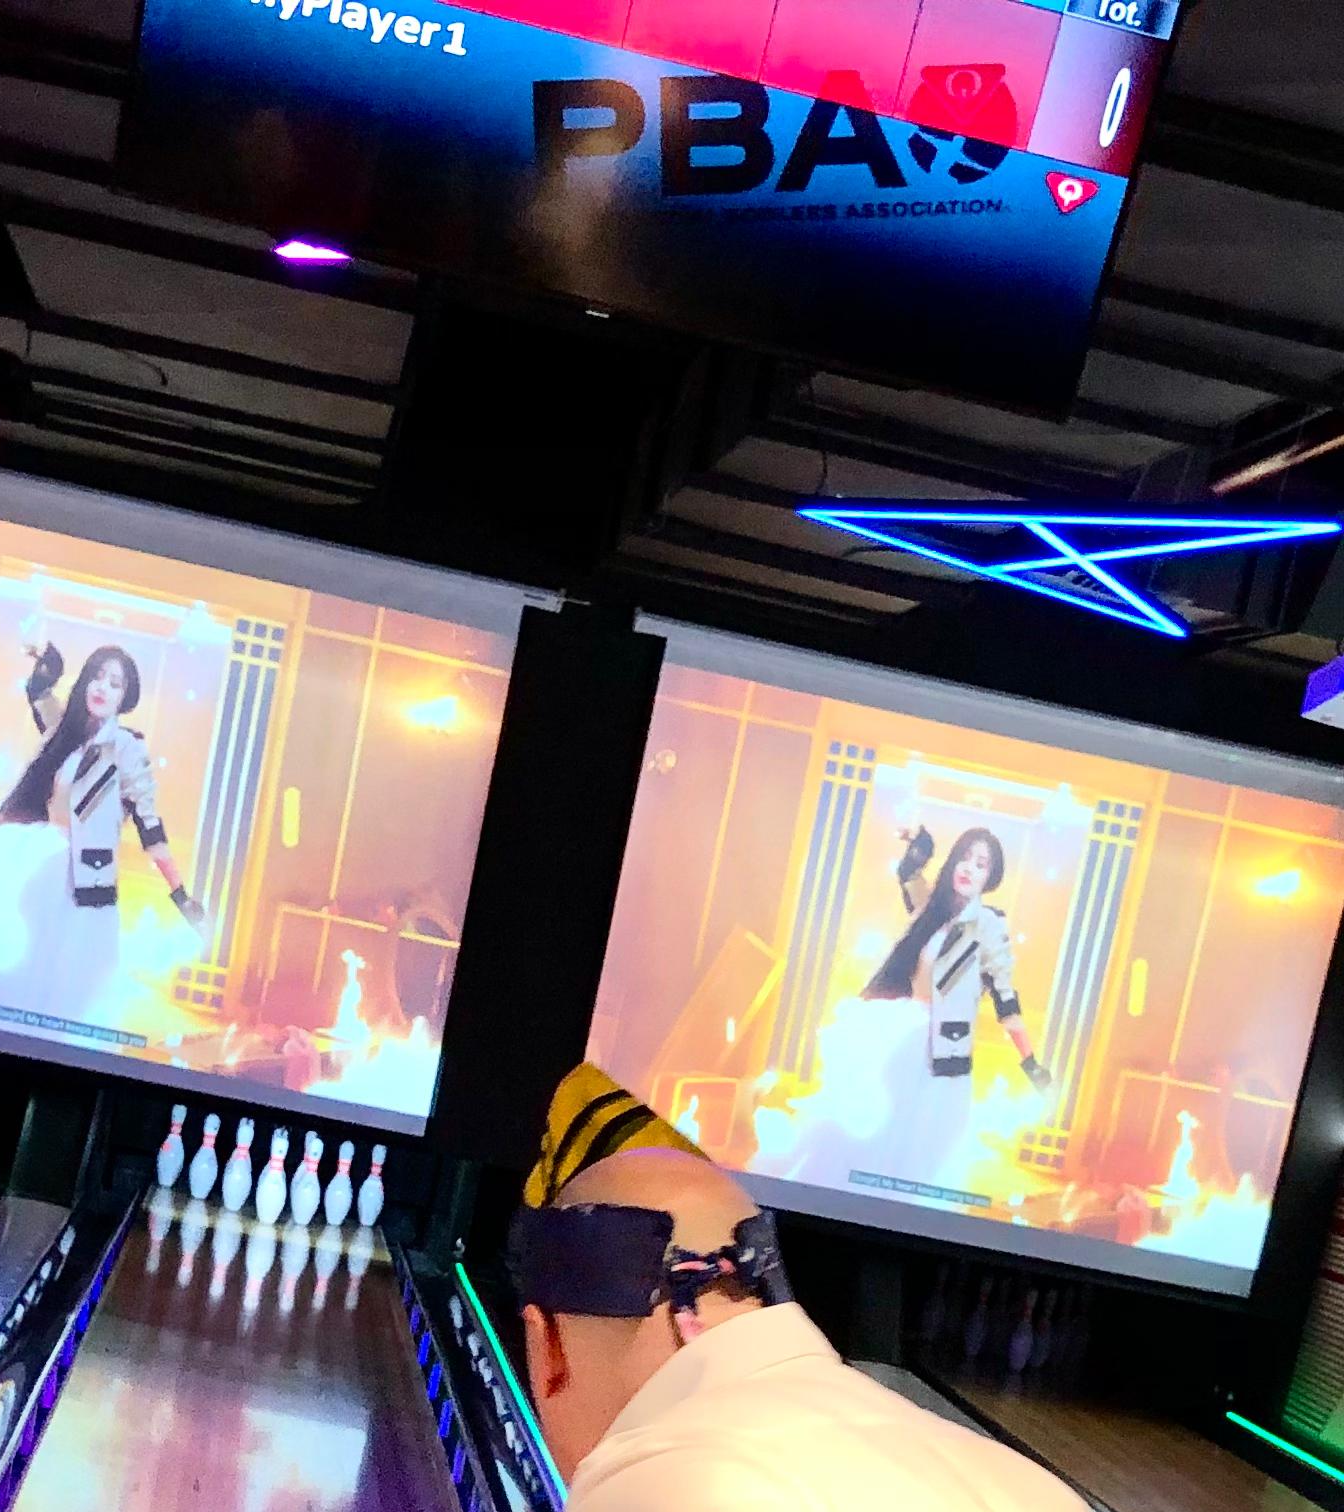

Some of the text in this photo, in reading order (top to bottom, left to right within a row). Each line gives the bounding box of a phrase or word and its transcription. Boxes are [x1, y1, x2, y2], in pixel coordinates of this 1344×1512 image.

[532, 70, 908, 196] PBA
[1099, 67, 1131, 147] 0
[846, 199, 1002, 220] ASSOCIATION
